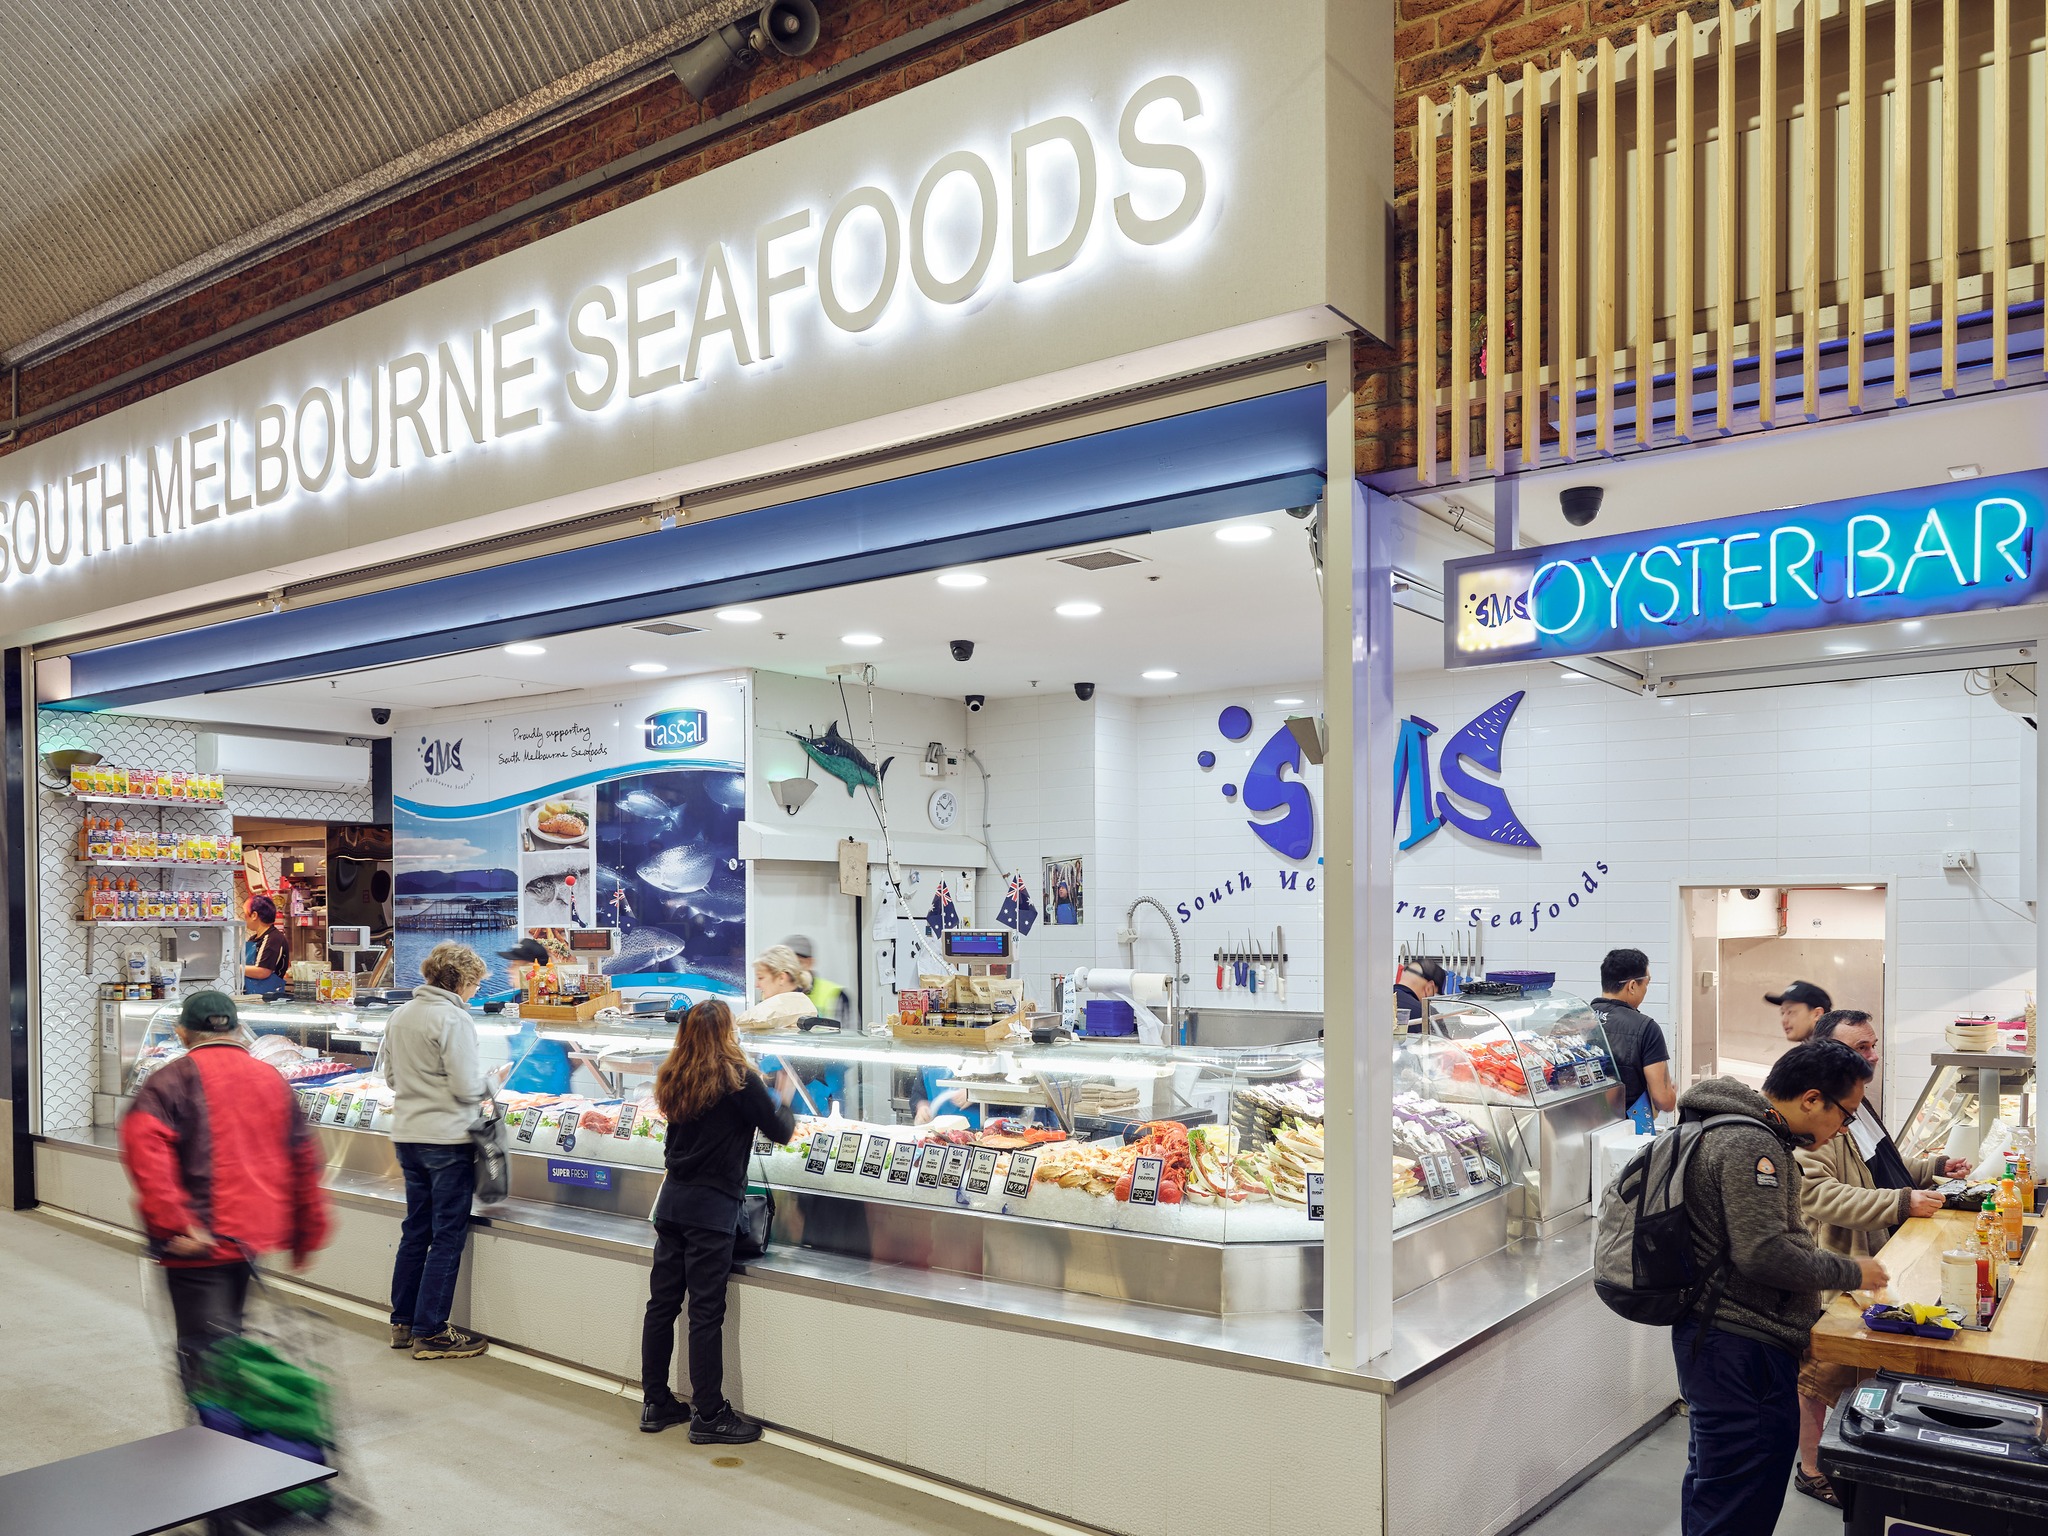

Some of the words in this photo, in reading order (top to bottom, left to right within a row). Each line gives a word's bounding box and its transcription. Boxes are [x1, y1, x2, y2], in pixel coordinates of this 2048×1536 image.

[147, 309, 542, 537] MELBOURNE
[566, 75, 1206, 411] SEAFOODS
[1526, 526, 1819, 635] OYSTER
[1846, 497, 2028, 598] BAR
[1476, 590, 1531, 628] SMS
[513, 727, 544, 748] Proudly
[546, 723, 591, 743] supporting
[650, 713, 702, 747] tassal
[424, 737, 464, 776] SMS
[498, 751, 521, 765] South
[523, 749, 568, 763] Melbourne
[571, 743, 608, 763] Seafoods
[1176, 871, 1251, 923] South
[1279, 868, 1445, 923] Merne
[1468, 860, 1609, 931] Seafoods
[552, 1168, 570, 1177] SUPER
[571, 1169, 589, 1179] FRESH
